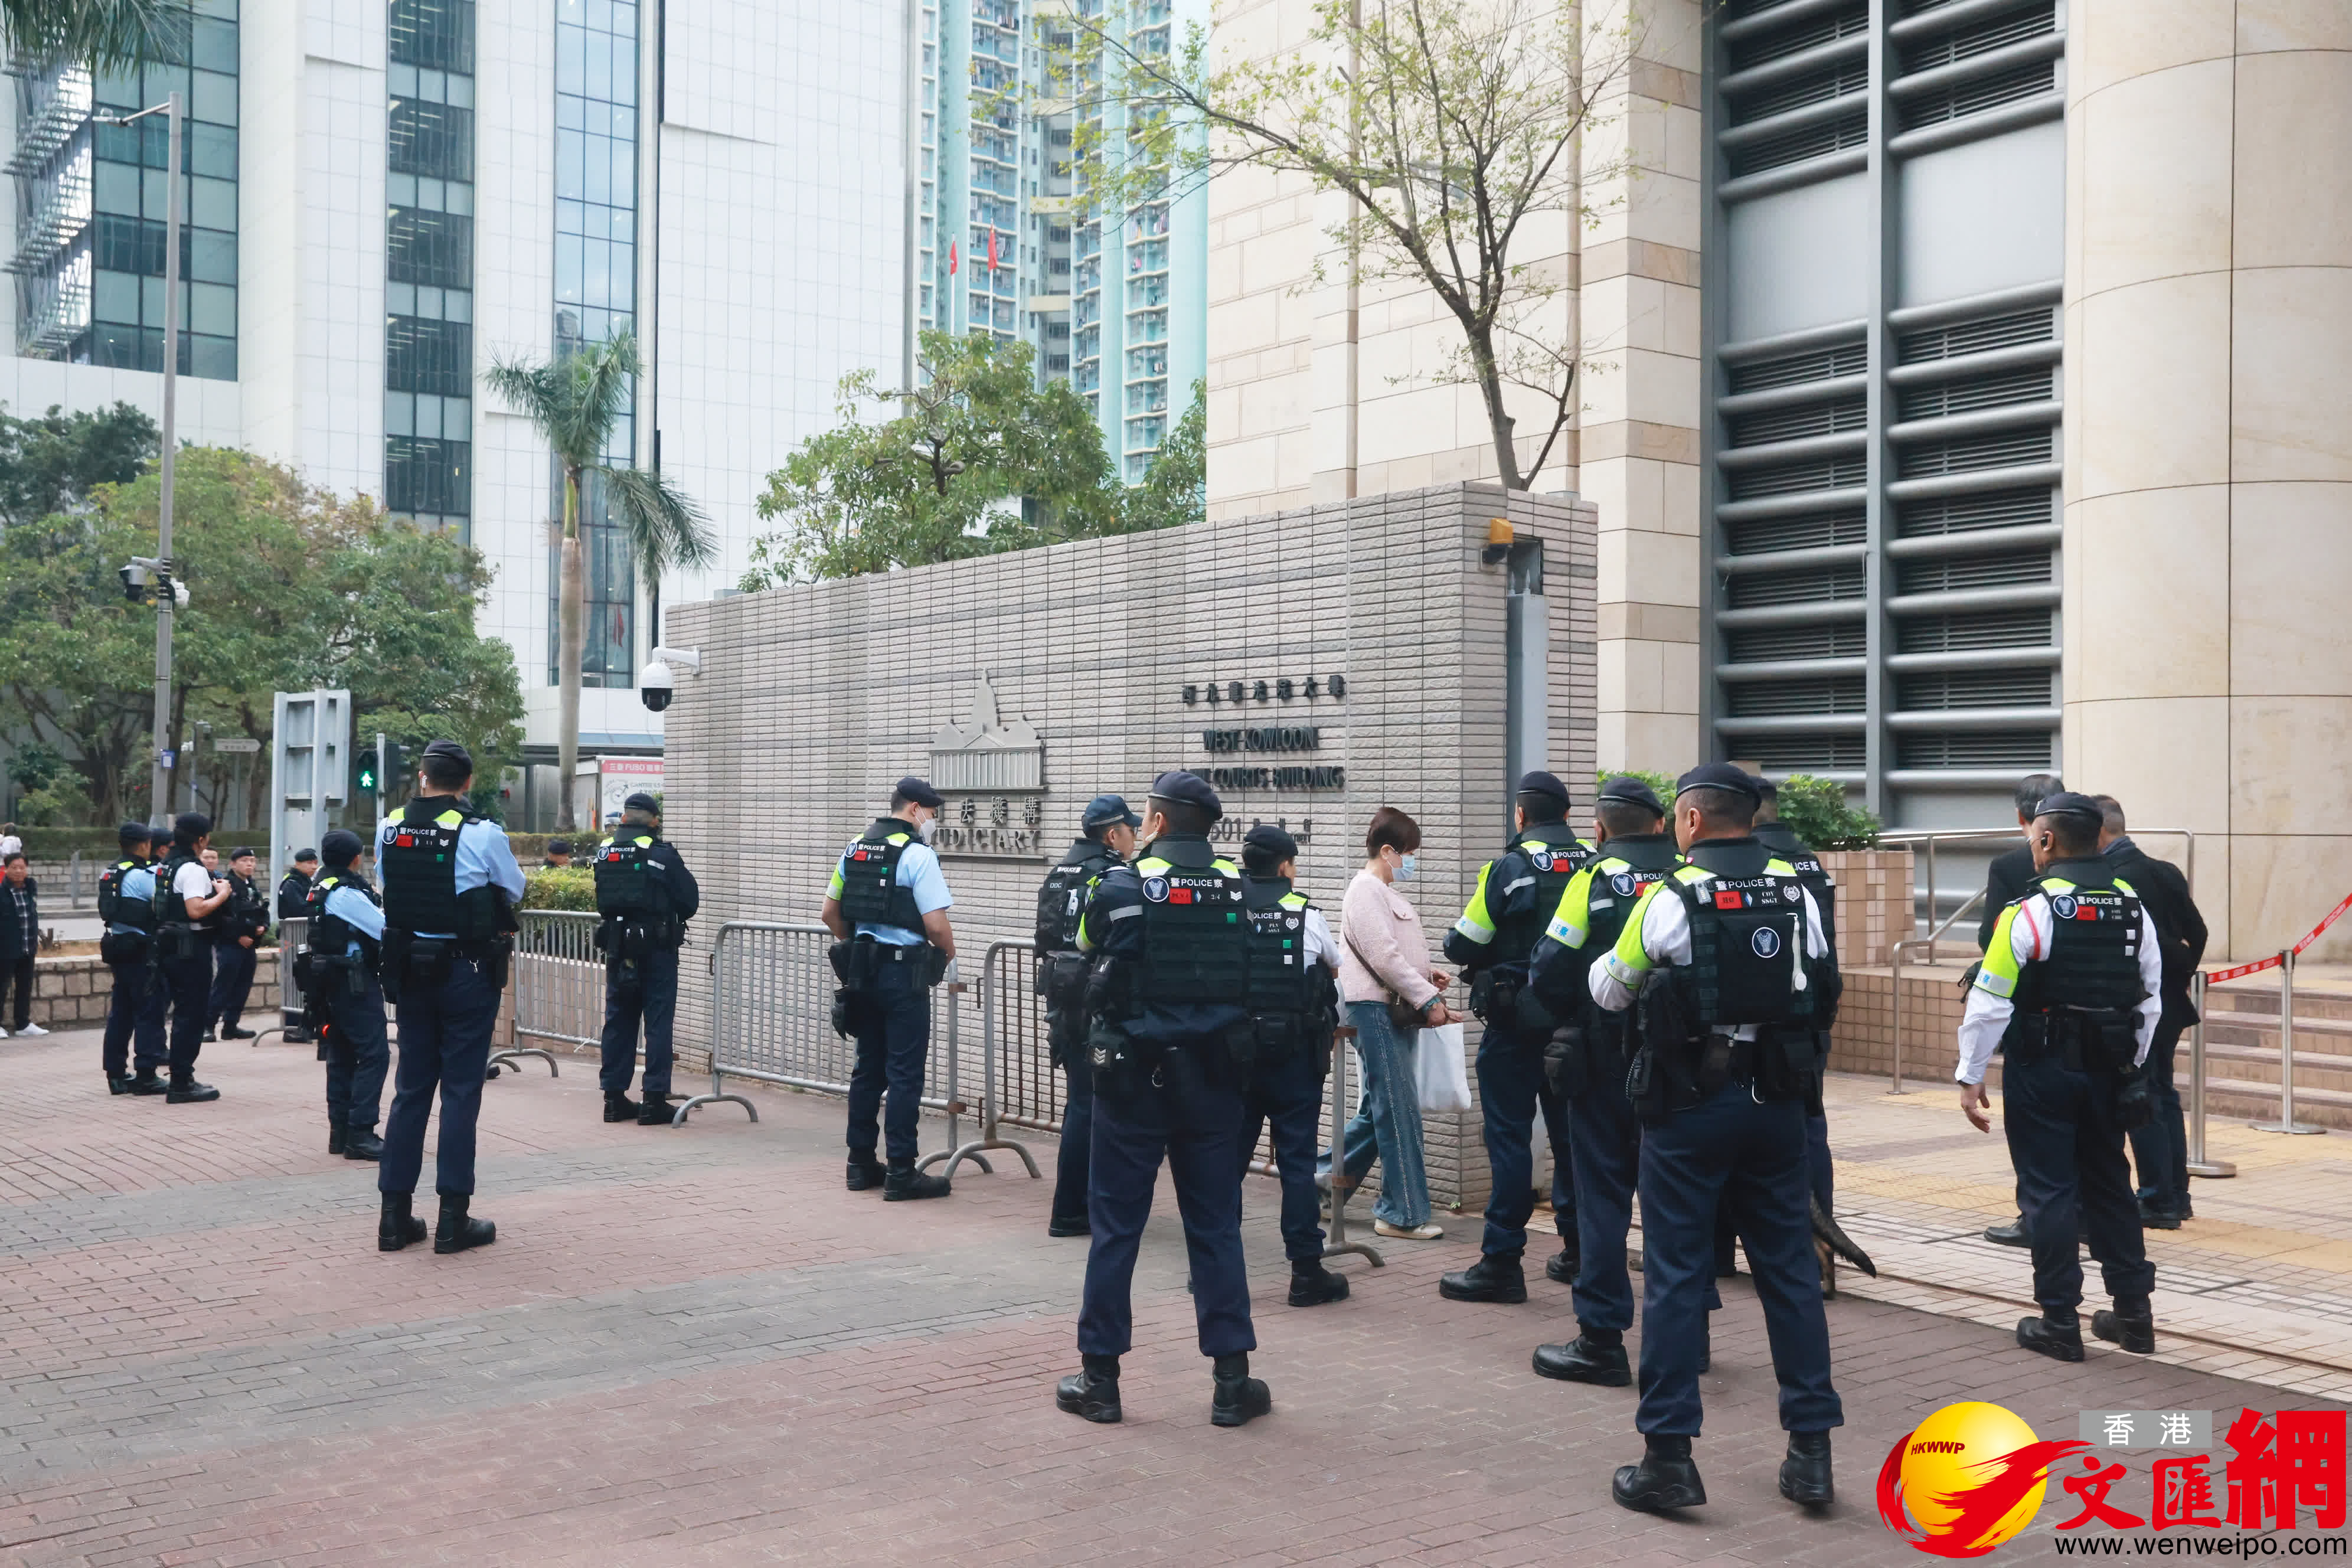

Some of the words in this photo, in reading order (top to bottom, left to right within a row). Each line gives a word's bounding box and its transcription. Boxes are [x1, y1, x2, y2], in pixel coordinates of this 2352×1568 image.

[1203, 729, 1239, 751] WEST
[1243, 727, 1318, 751] KOWLOON
[1213, 767, 1269, 788] COURTS
[1273, 766, 1345, 788] BUILDING
